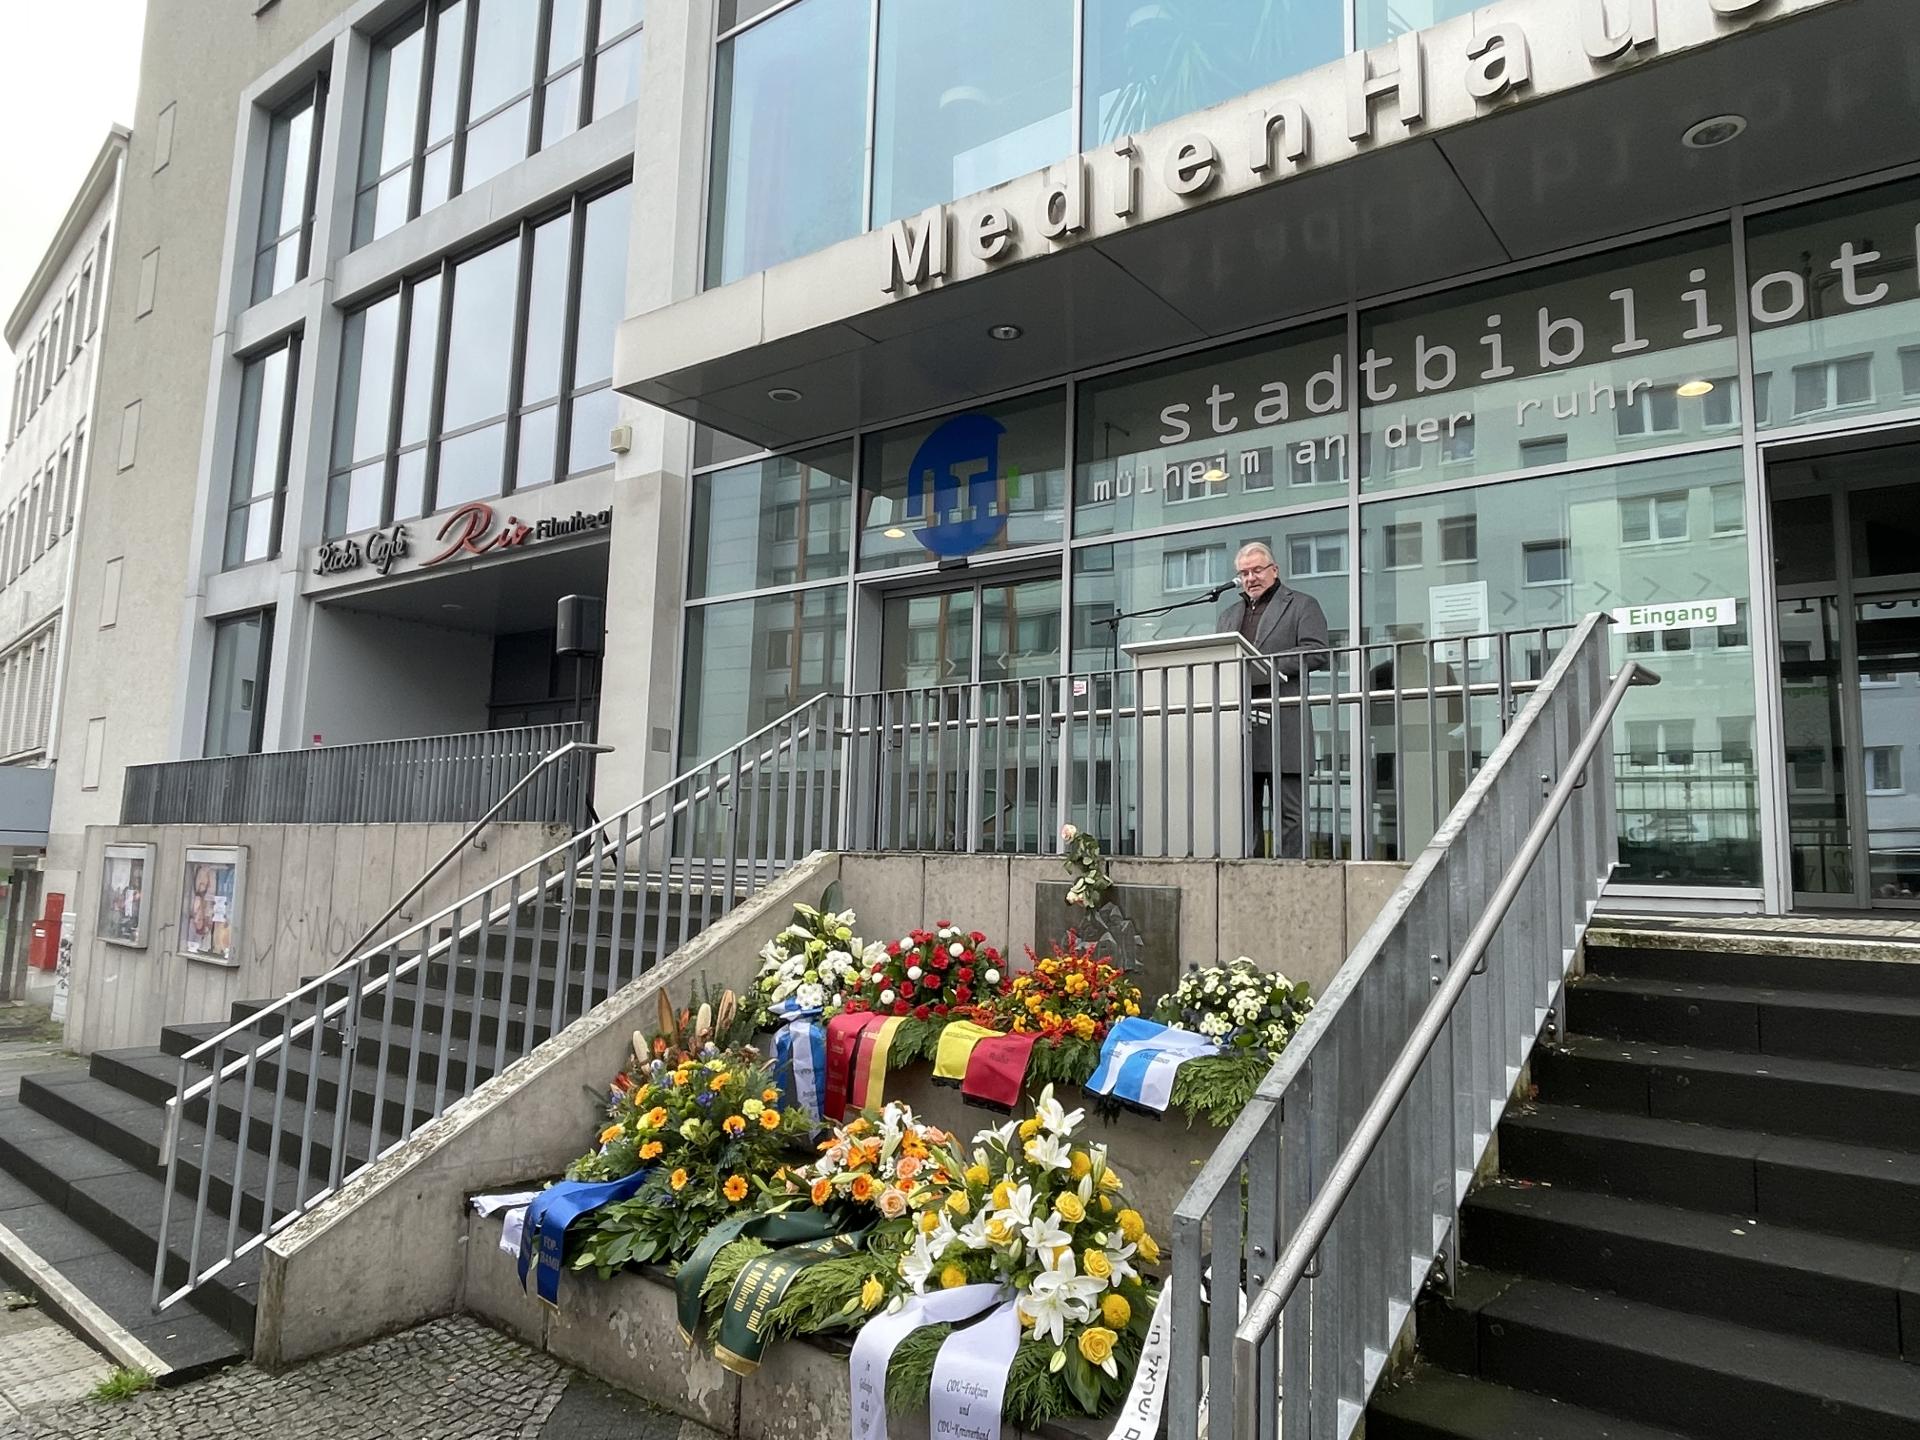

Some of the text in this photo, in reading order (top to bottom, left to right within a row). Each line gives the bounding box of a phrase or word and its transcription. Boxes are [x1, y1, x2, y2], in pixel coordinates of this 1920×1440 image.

[881, 0, 1760, 293] MedienHau
[1159, 222, 1920, 444] stadtbibliot
[1094, 376, 1653, 502] mülheim an der ruhr
[536, 505, 613, 539] Filmthea
[1629, 605, 1718, 626] Eingang
[1138, 1355, 1162, 1422] ישראל
